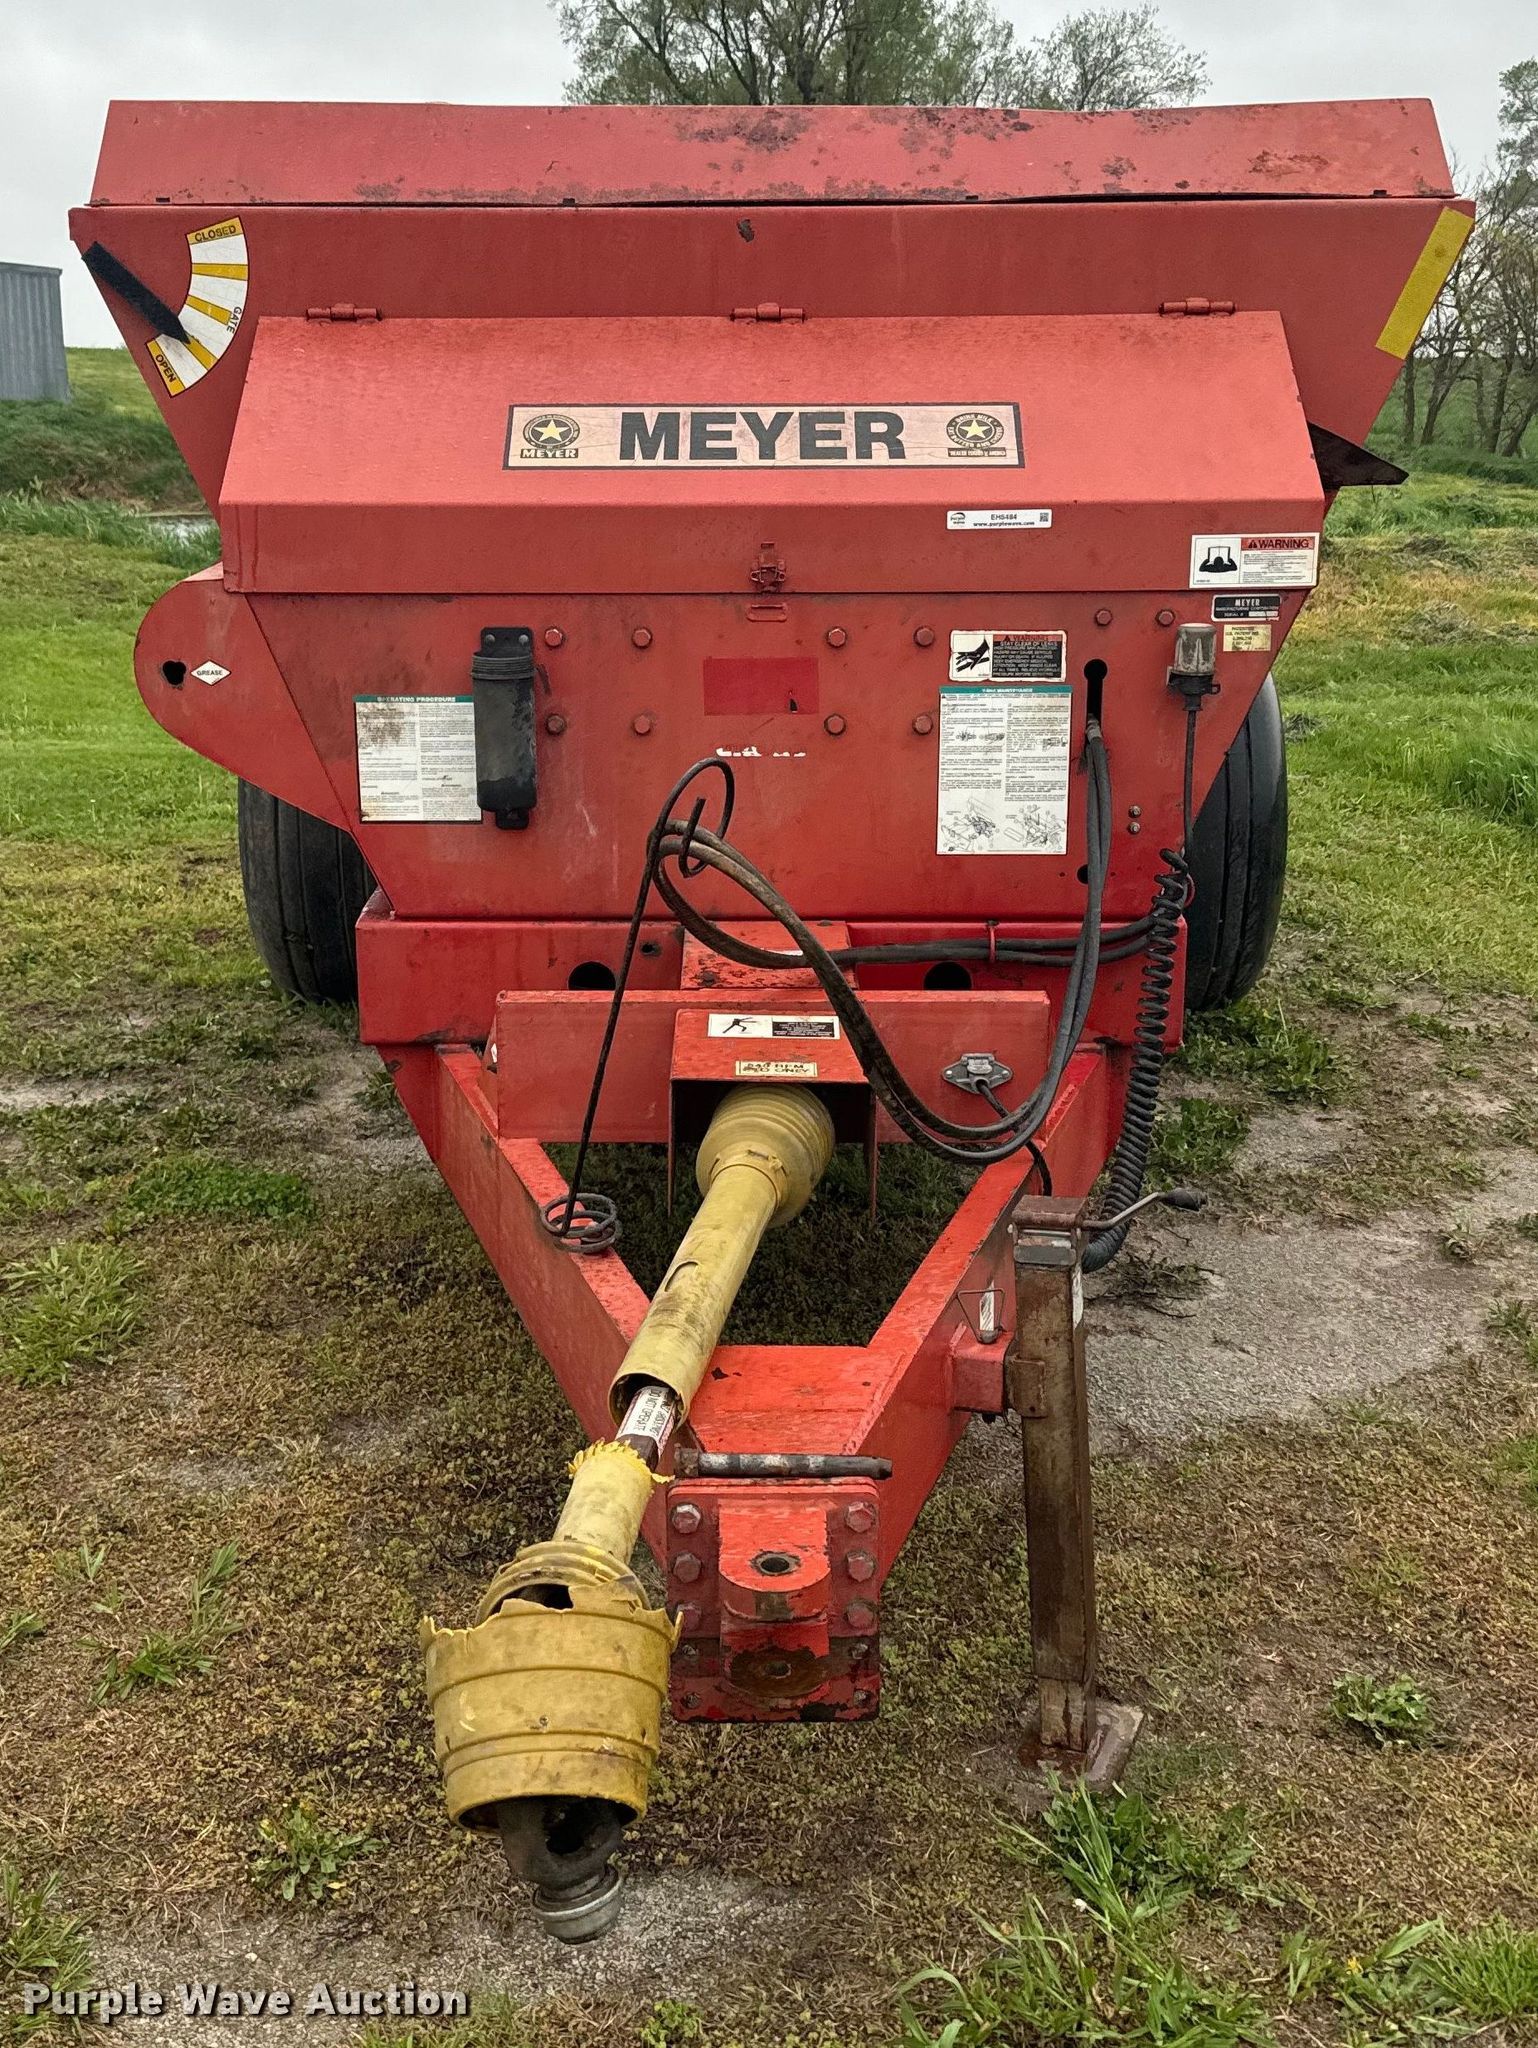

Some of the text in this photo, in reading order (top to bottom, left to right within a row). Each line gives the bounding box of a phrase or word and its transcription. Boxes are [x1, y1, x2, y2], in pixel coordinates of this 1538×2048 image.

[194, 224, 236, 243] CLOSED
[226, 306, 243, 334] GATE
[155, 354, 177, 383] OPEN
[619, 411, 907, 461] MEYER
[522, 449, 577, 458] MEYER
[1258, 538, 1310, 549] WARNING
[1234, 598, 1260, 607] MEYER
